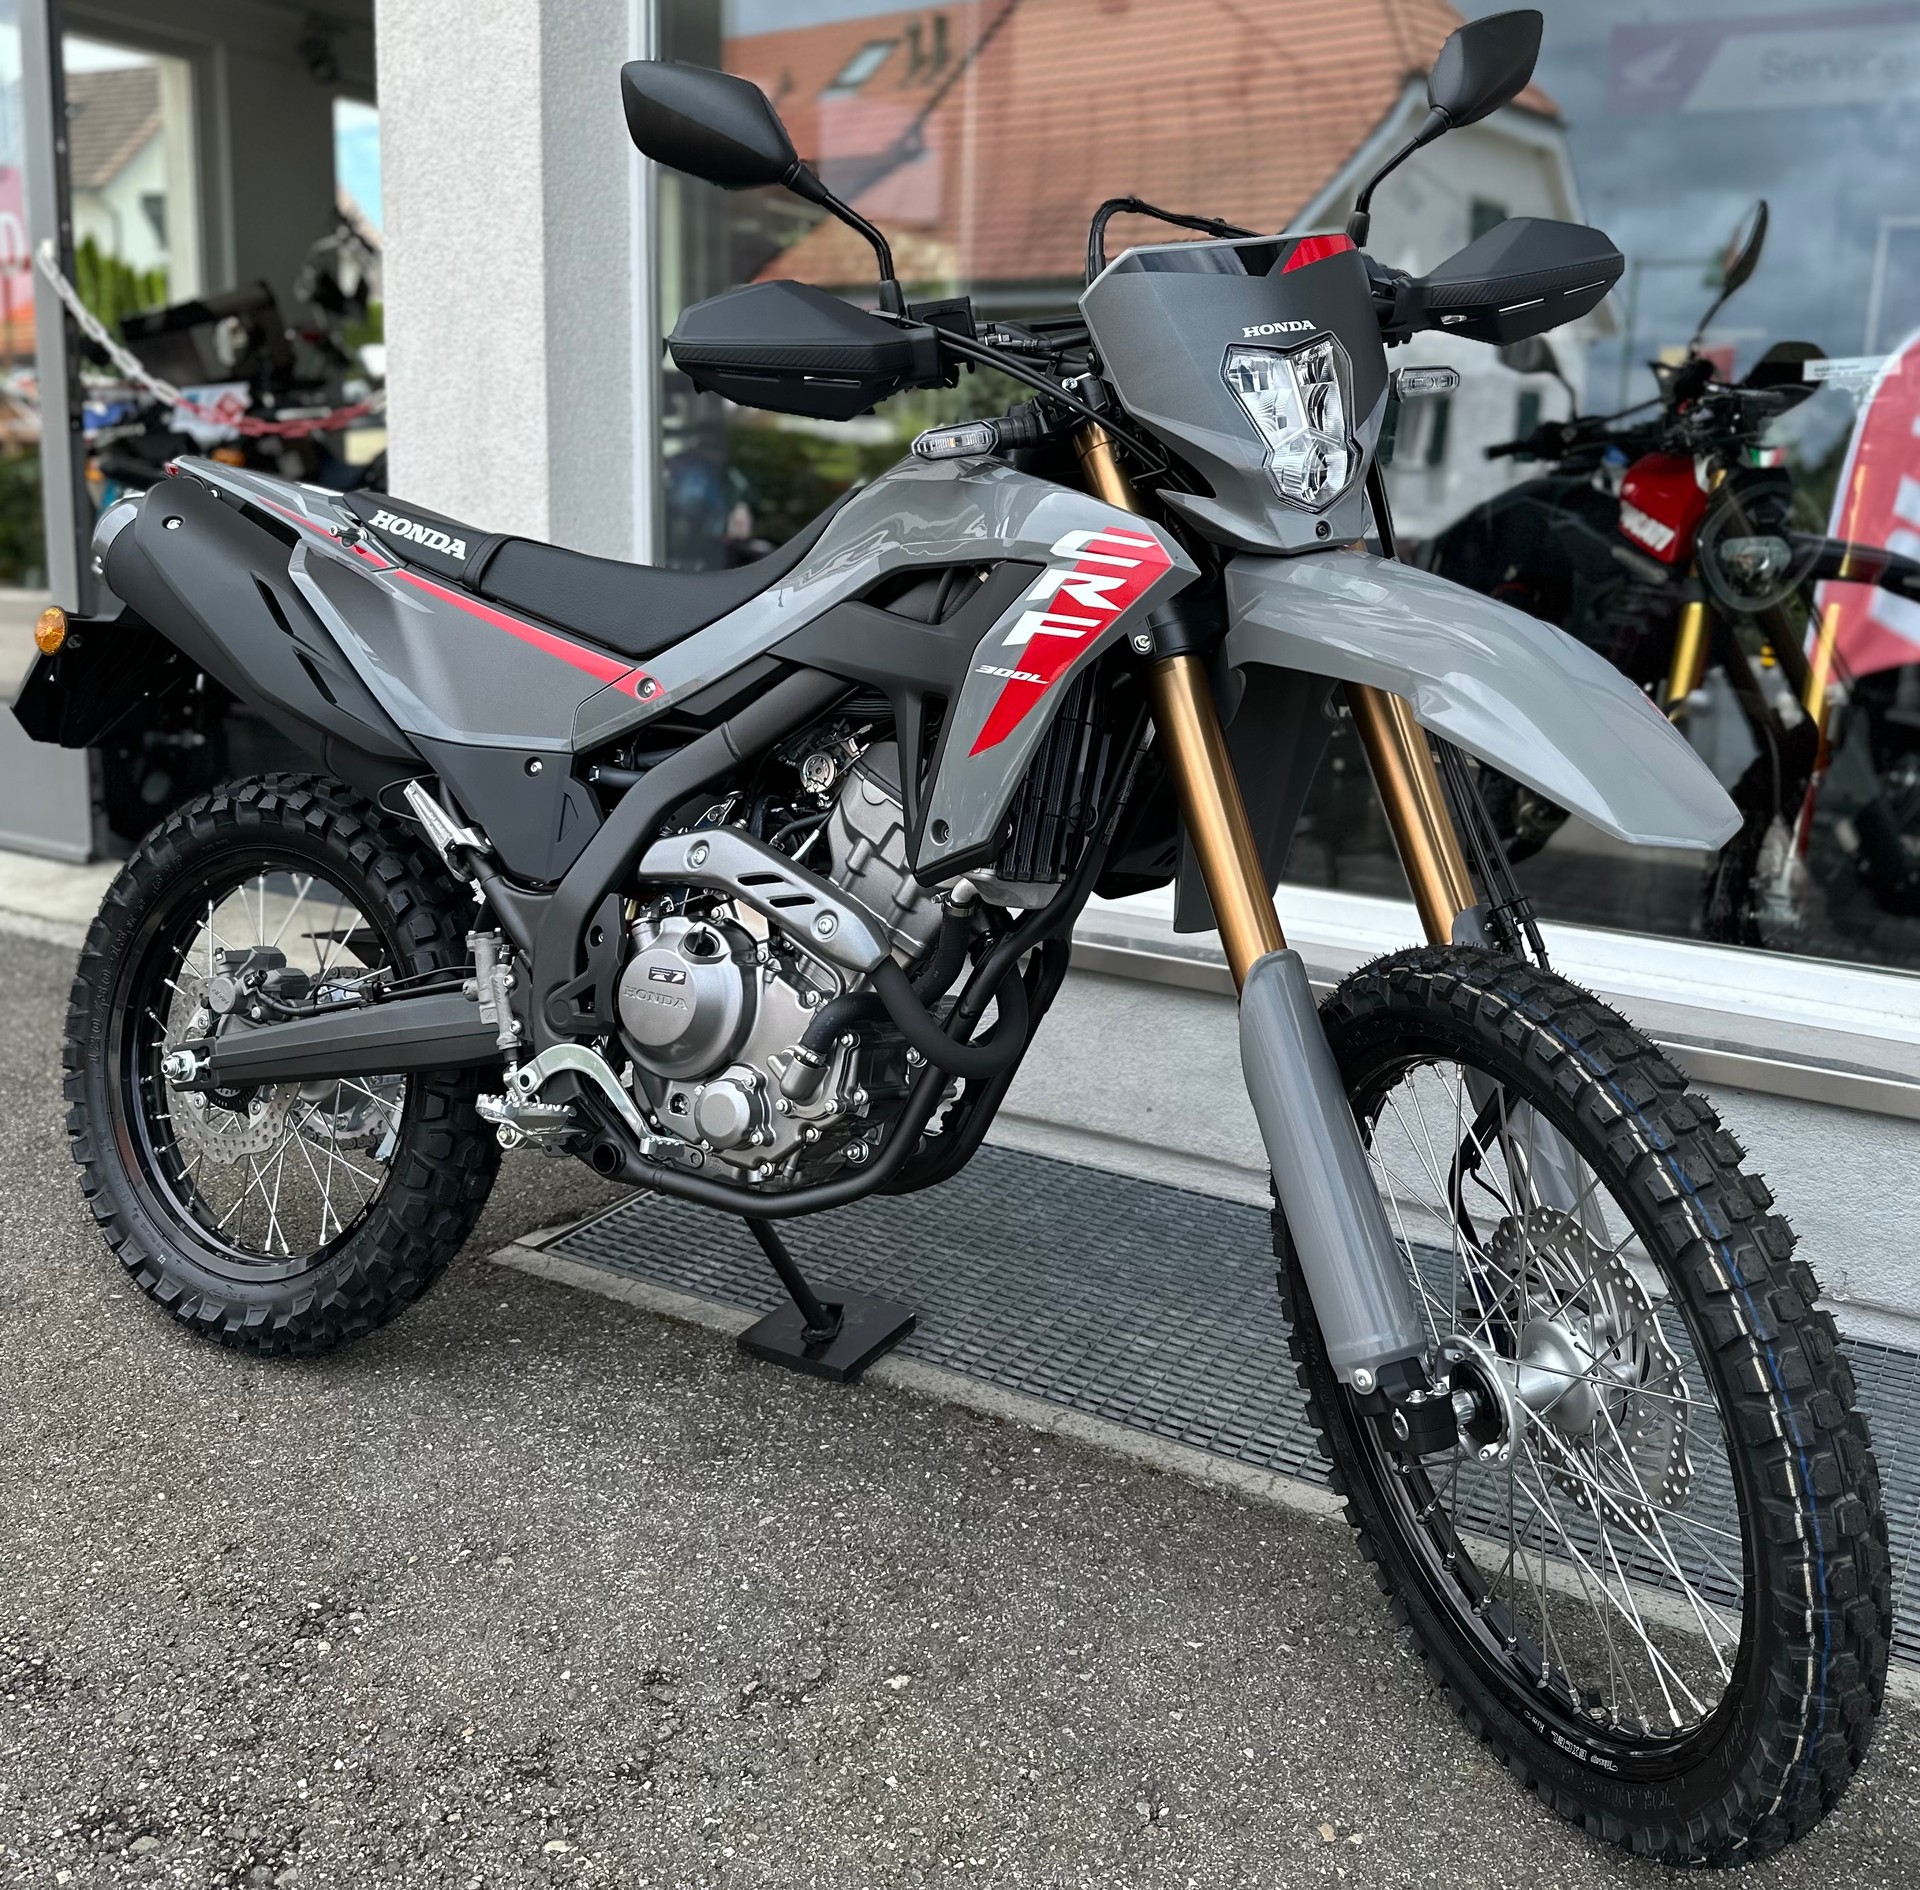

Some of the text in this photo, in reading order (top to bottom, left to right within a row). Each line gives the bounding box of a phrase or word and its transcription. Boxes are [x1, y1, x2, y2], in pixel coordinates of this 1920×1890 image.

[1242, 320, 1316, 338] HONDA
[368, 509, 466, 560] HONDA
[1001, 529, 1158, 647] CRF
[975, 664, 1050, 685] 300L
[622, 985, 689, 1010] HONDA
[1550, 1730, 1589, 1762] EXCEL
